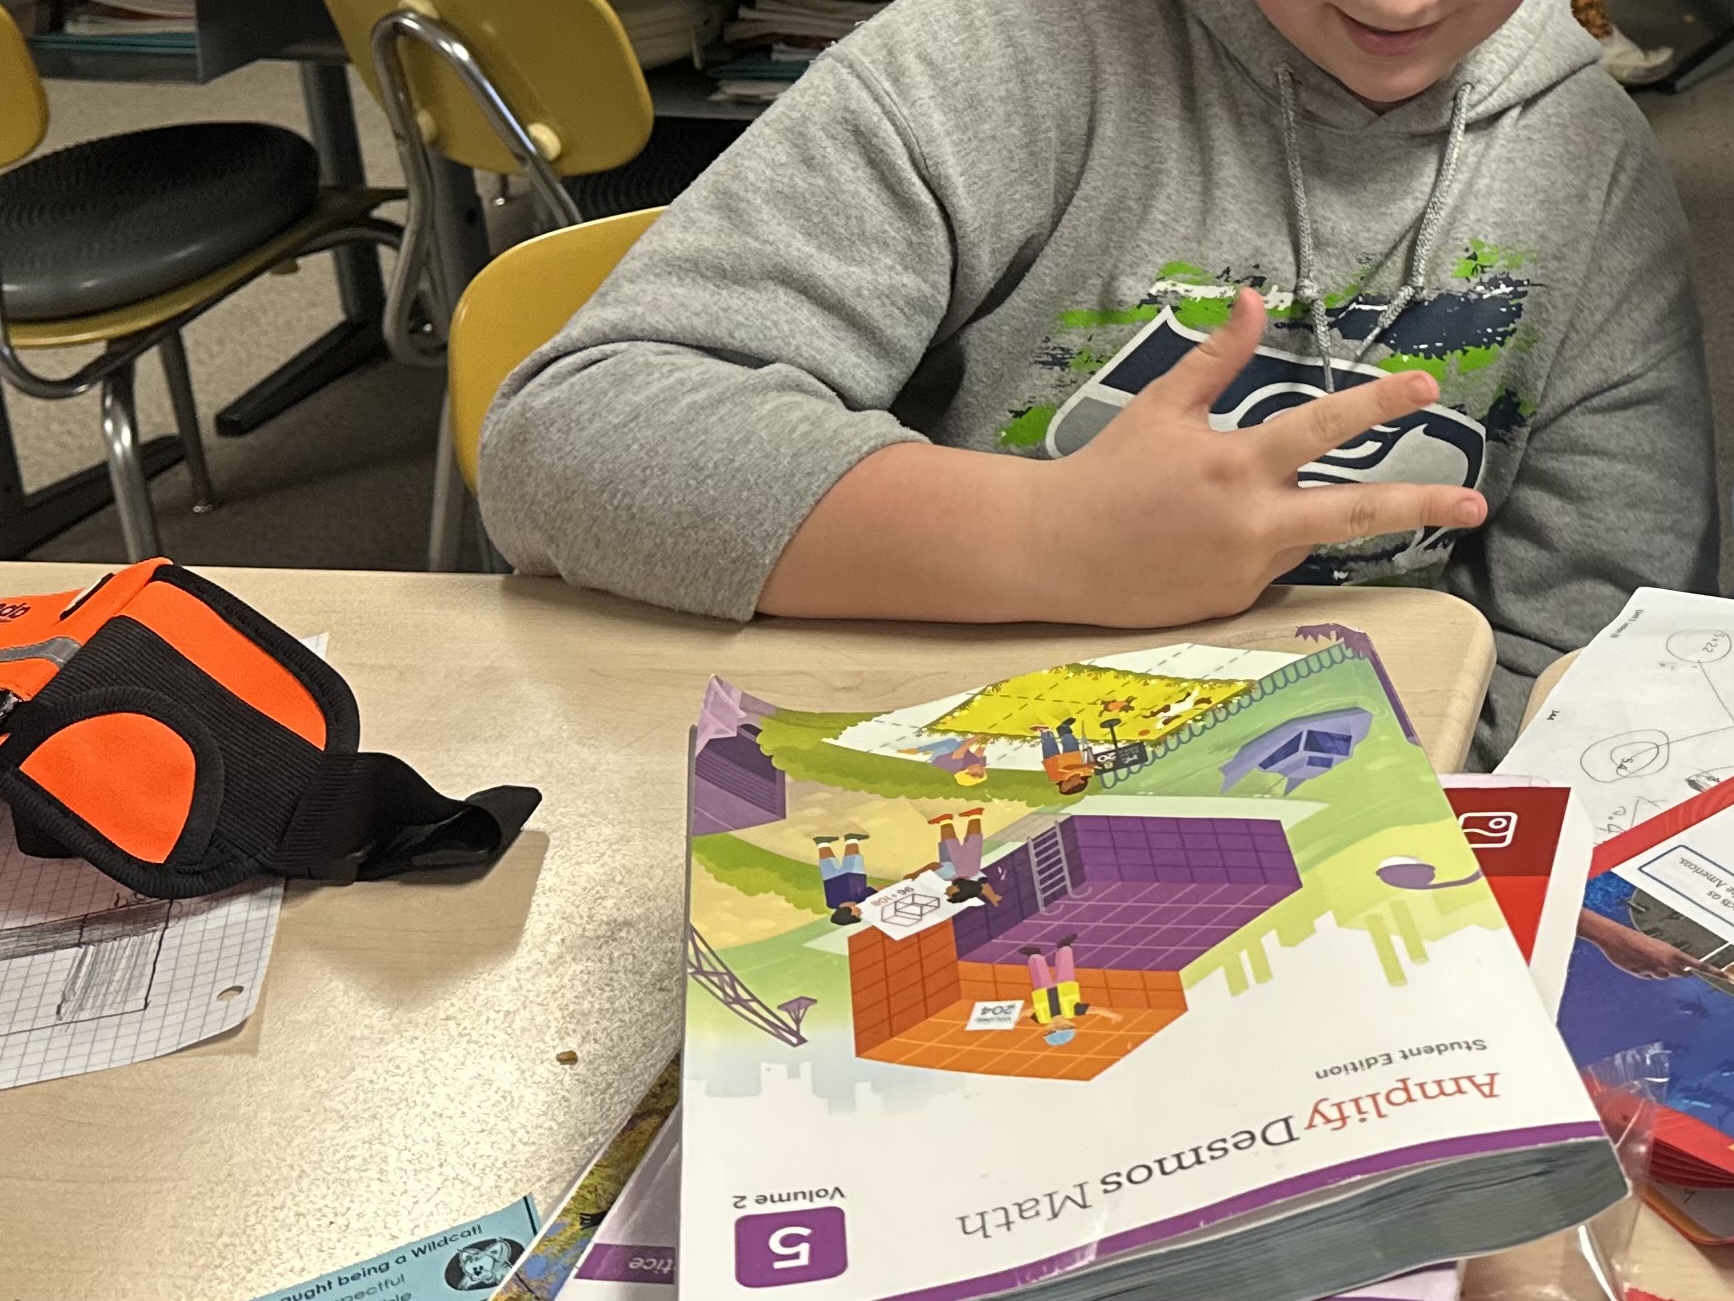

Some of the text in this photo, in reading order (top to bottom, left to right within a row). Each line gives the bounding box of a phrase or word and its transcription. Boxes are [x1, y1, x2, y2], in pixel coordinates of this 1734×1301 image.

[1680, 857, 1727, 888] Americas.
[1314, 1037, 1488, 1081] Student Edition
[956, 1070, 1502, 1240] Amplify Desmos Math
[731, 1186, 847, 1210] Volume 2
[767, 1223, 812, 1271] 5
[336, 1262, 388, 1291] being
